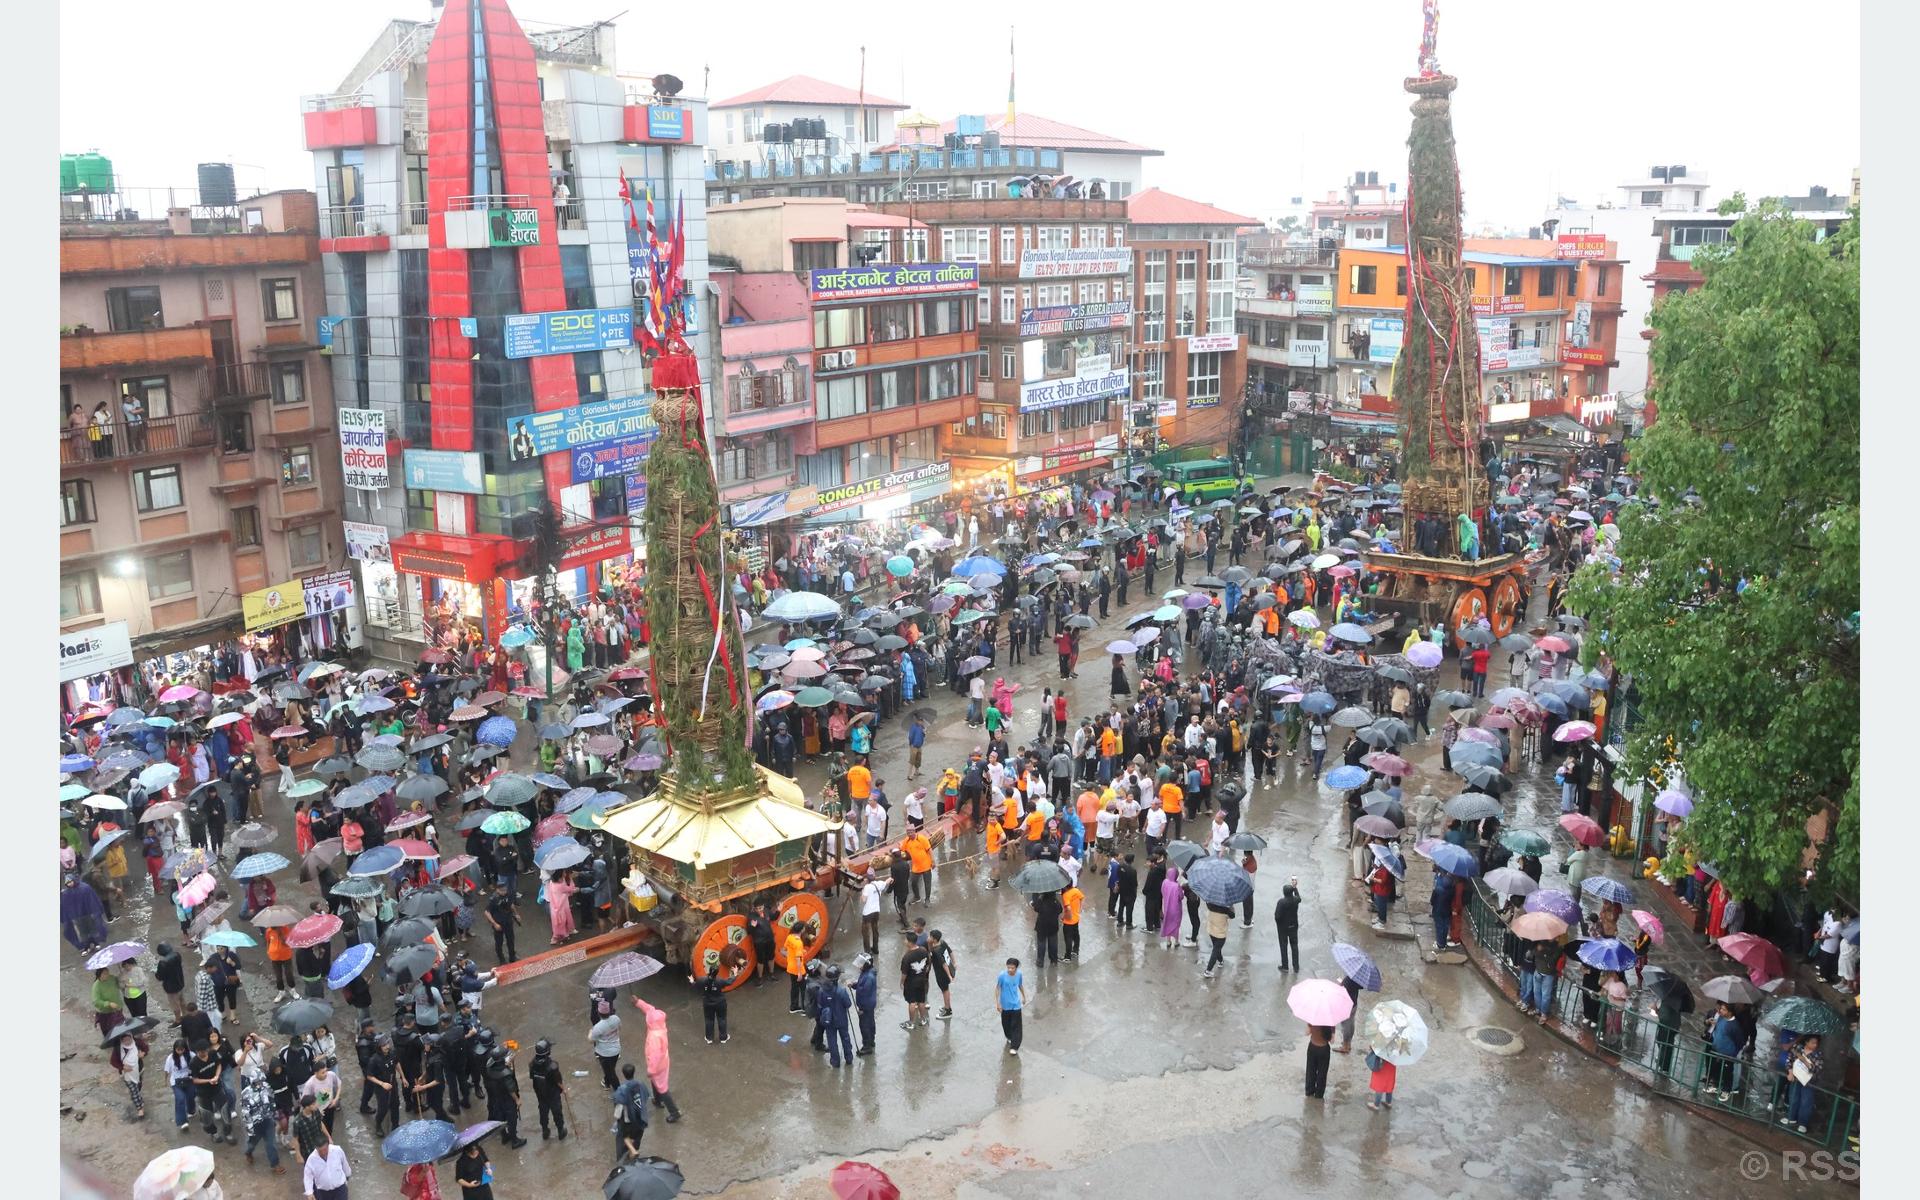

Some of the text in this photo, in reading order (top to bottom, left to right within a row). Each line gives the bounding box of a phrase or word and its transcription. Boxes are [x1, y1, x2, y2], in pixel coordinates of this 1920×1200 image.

[511, 209, 538, 224] जनता
[629, 248, 651, 258] STUDY
[895, 267, 931, 286] होटल
[935, 264, 974, 281] तालिम
[607, 313, 630, 324] IELTS
[1040, 321, 1062, 334] CANADA
[1075, 319, 1084, 330] US
[608, 328, 624, 338] PTE
[1076, 377, 1098, 396] होटल
[1100, 372, 1124, 392] तालिम
[582, 406, 608, 416] Glorious
[609, 400, 626, 413] Nepal
[342, 429, 384, 447] जापानीज
[344, 448, 386, 469] कोरियन
[884, 472, 914, 488] होटल
[917, 462, 950, 479] तालिम
